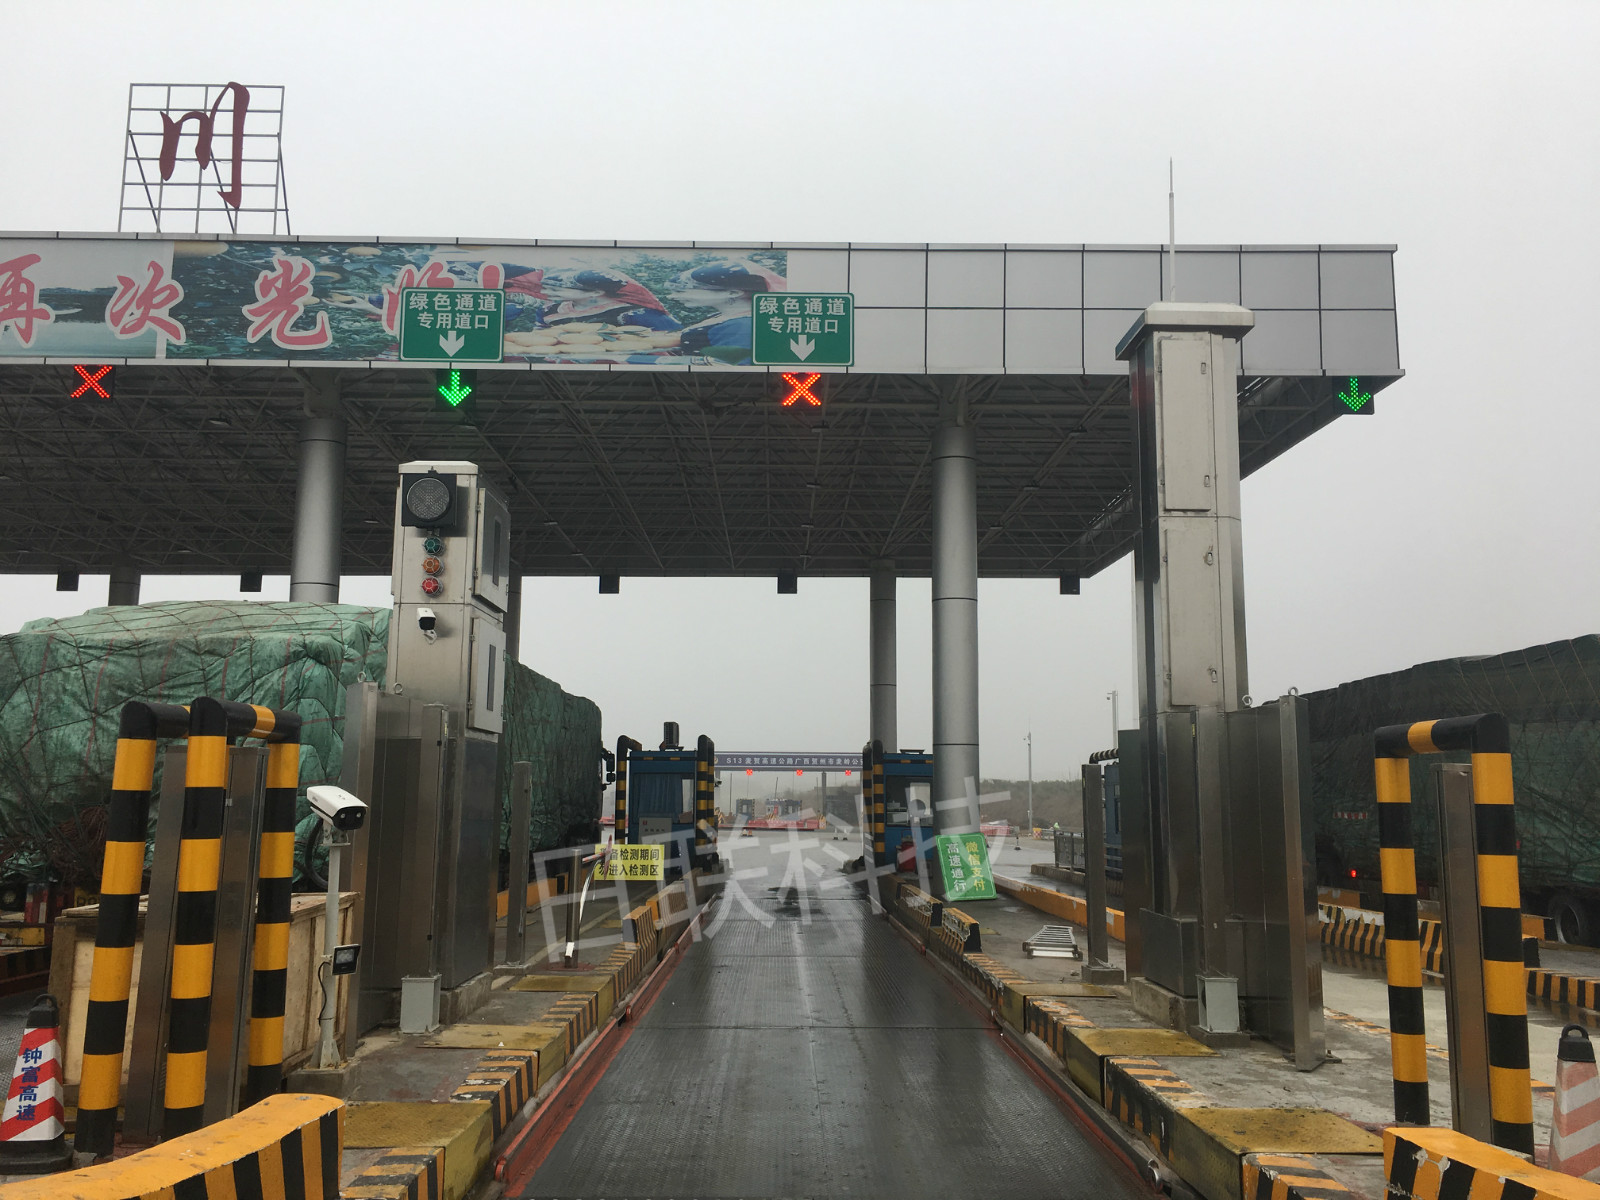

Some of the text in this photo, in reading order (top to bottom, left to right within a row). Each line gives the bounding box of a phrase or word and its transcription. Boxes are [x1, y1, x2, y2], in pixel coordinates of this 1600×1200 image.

[409, 293, 497, 312] 绿色通道
[759, 297, 846, 316] 绿色通道
[417, 312, 489, 329] 专用道口
[768, 316, 838, 334] 专用道口
[600, 848, 660, 861] 备检测期间
[947, 842, 966, 891] 高速通行
[966, 842, 985, 891] 微信支付
[16, 1047, 42, 1121] 钟富高速
